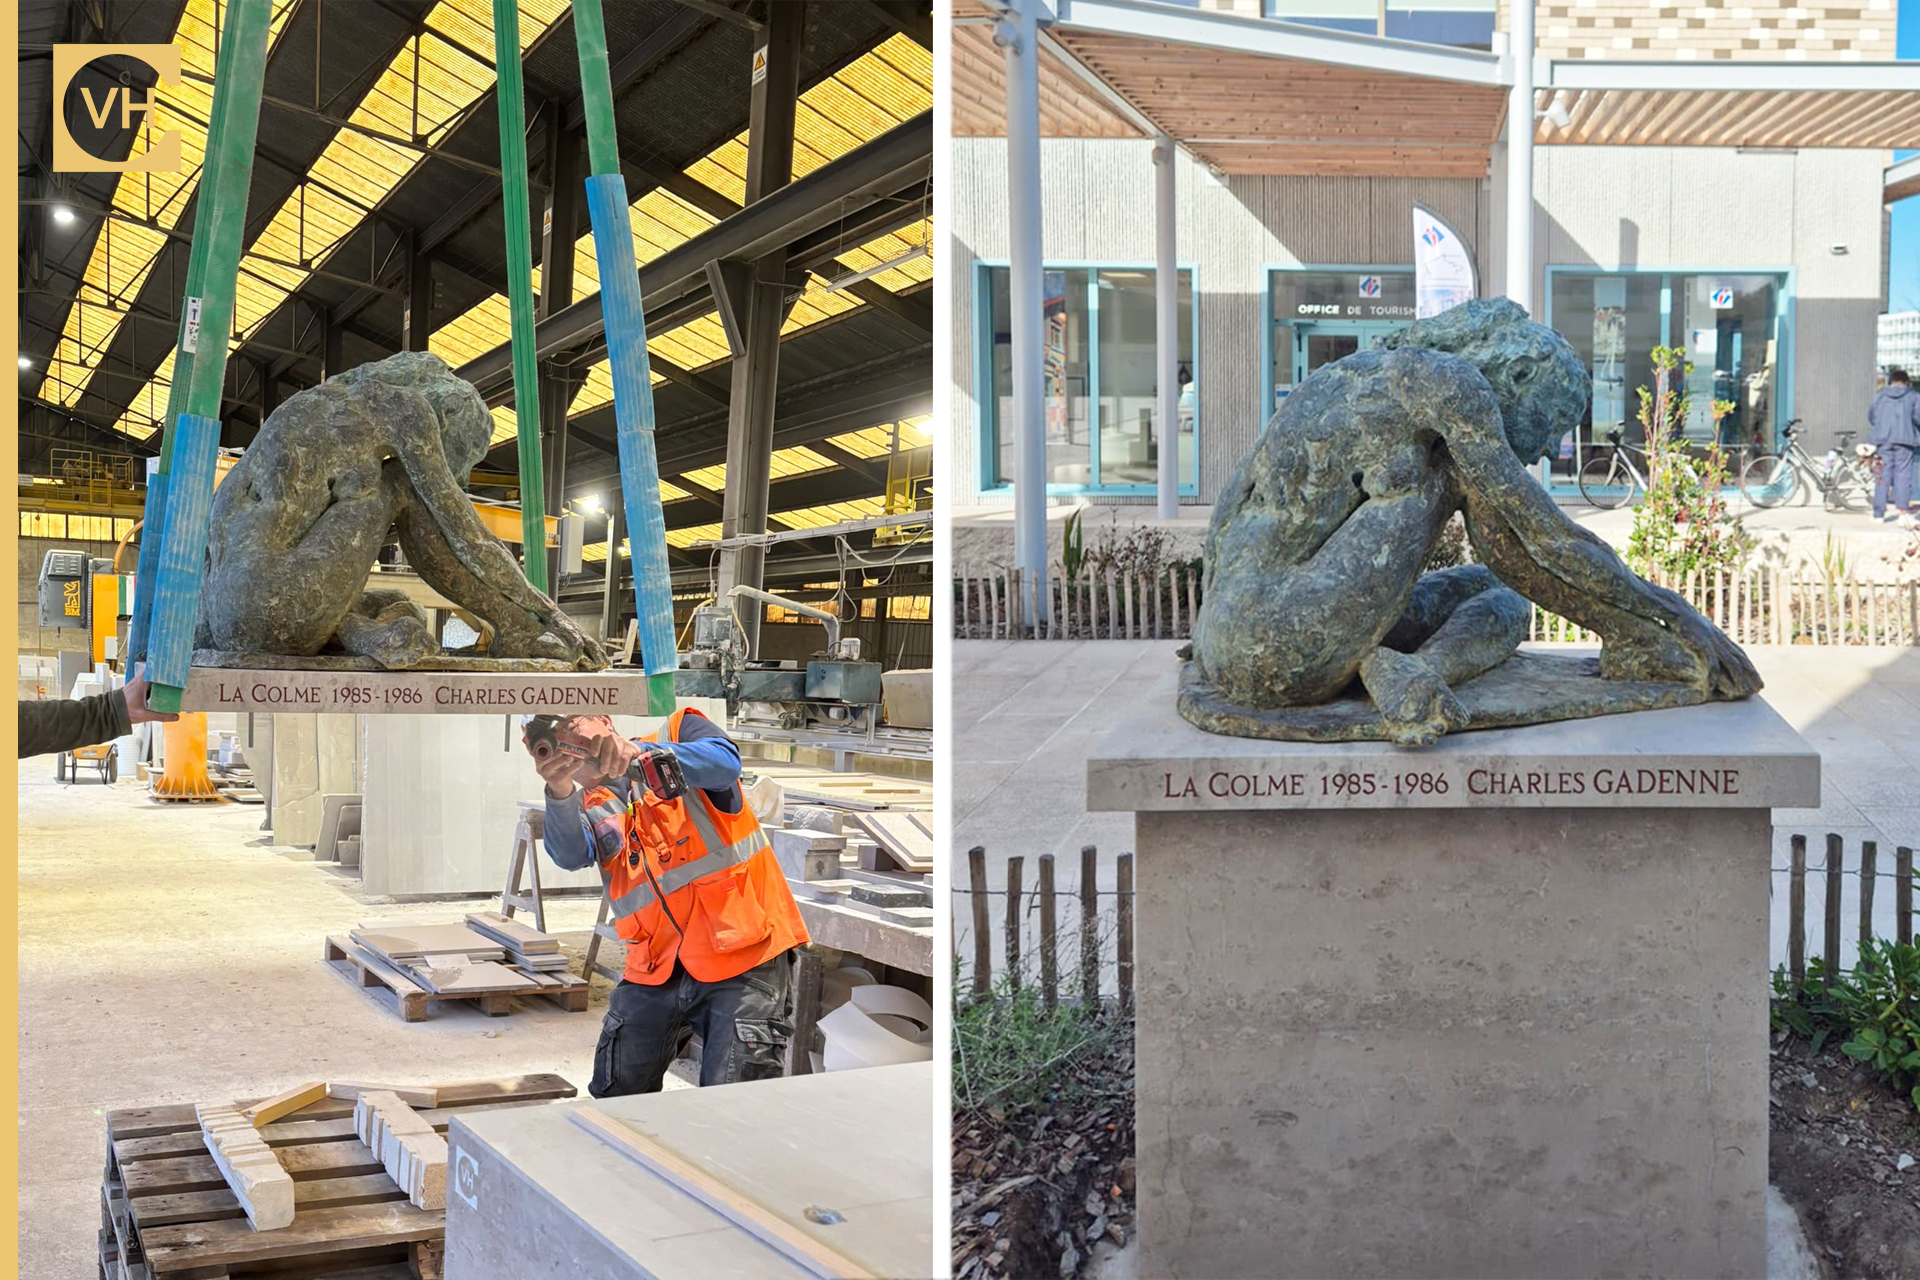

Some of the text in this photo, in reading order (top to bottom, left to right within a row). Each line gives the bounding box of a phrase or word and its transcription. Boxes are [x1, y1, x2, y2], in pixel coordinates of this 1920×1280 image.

[1298, 304, 1417, 316] OFFICE DE TOURISM
[64, 608, 80, 616] BM
[435, 686, 516, 705] CHARLES
[521, 687, 619, 705] GADENNE
[1467, 769, 1585, 794] CHARLES
[1593, 769, 1739, 794] GADENNE
